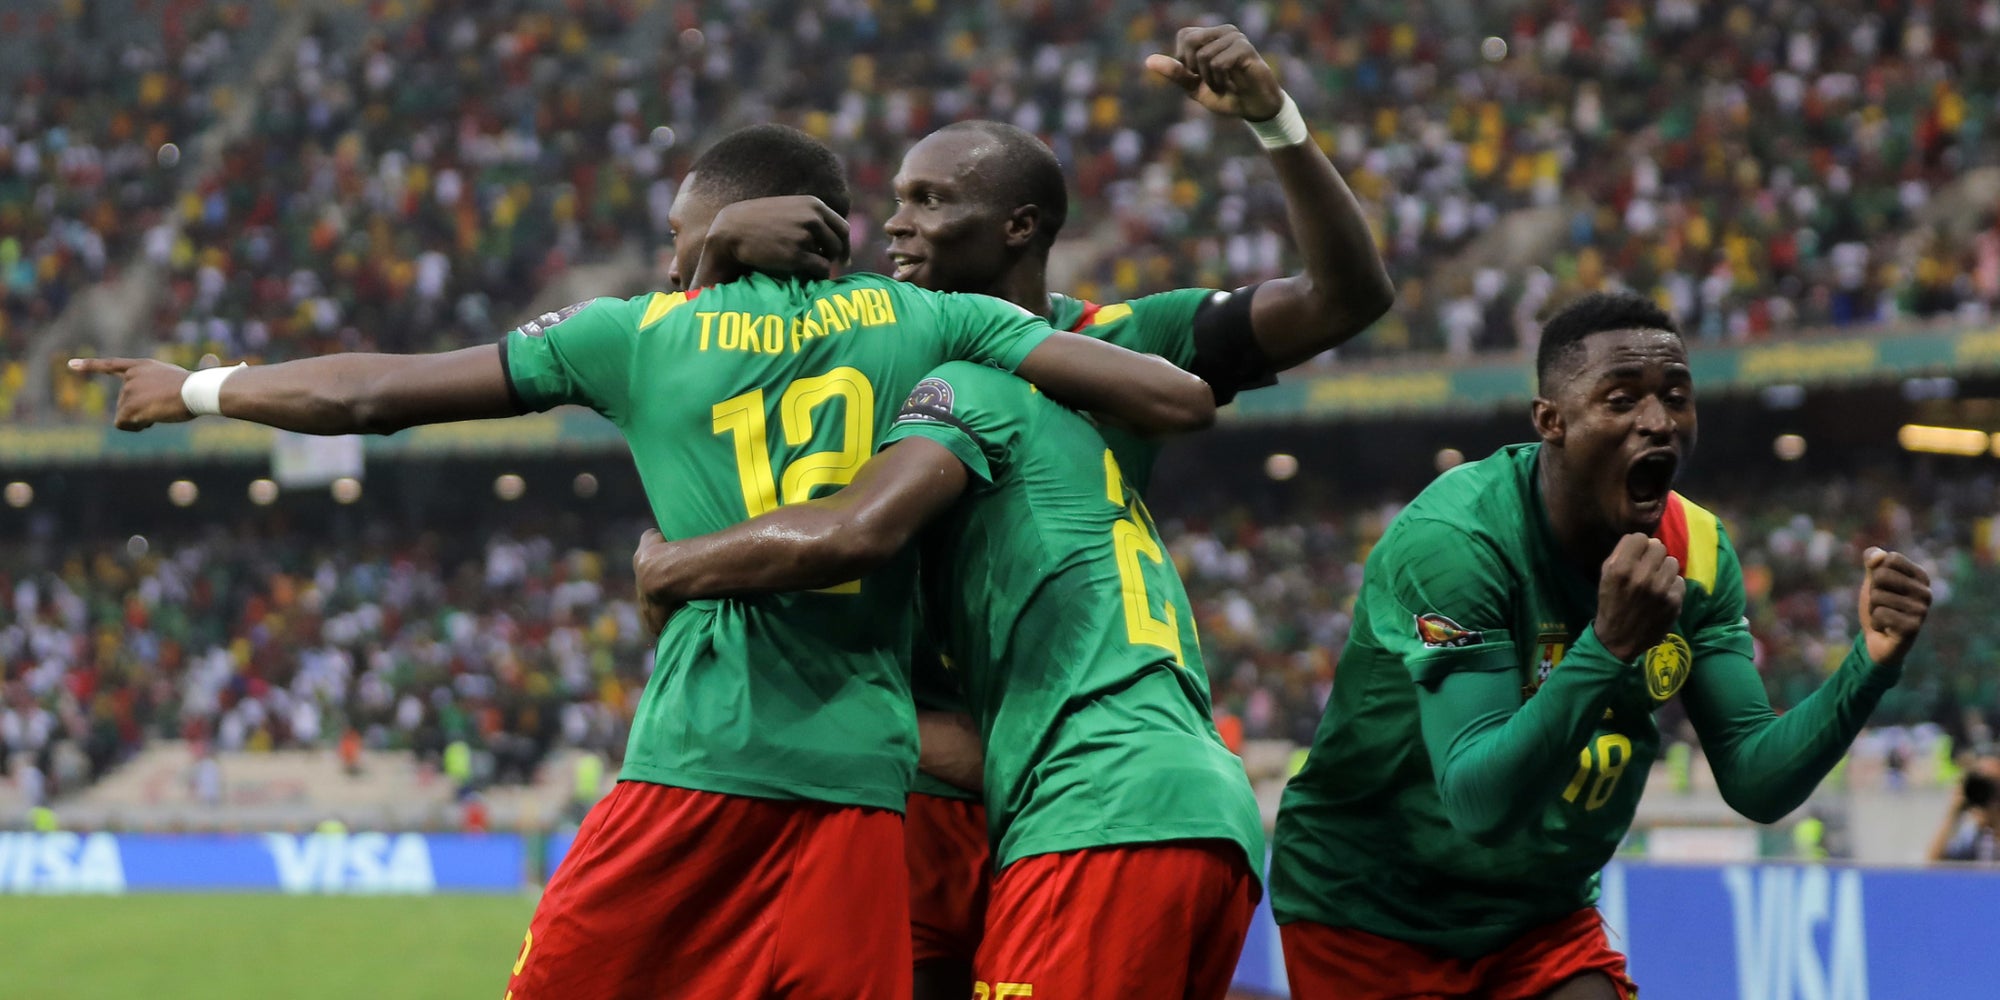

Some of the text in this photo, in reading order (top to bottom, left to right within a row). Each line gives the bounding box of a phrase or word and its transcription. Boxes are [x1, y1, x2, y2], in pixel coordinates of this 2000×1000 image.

[696, 311, 784, 354] TOKO
[713, 366, 875, 594] 12
[1562, 734, 1632, 812] 18
[262, 831, 437, 893] VISA
